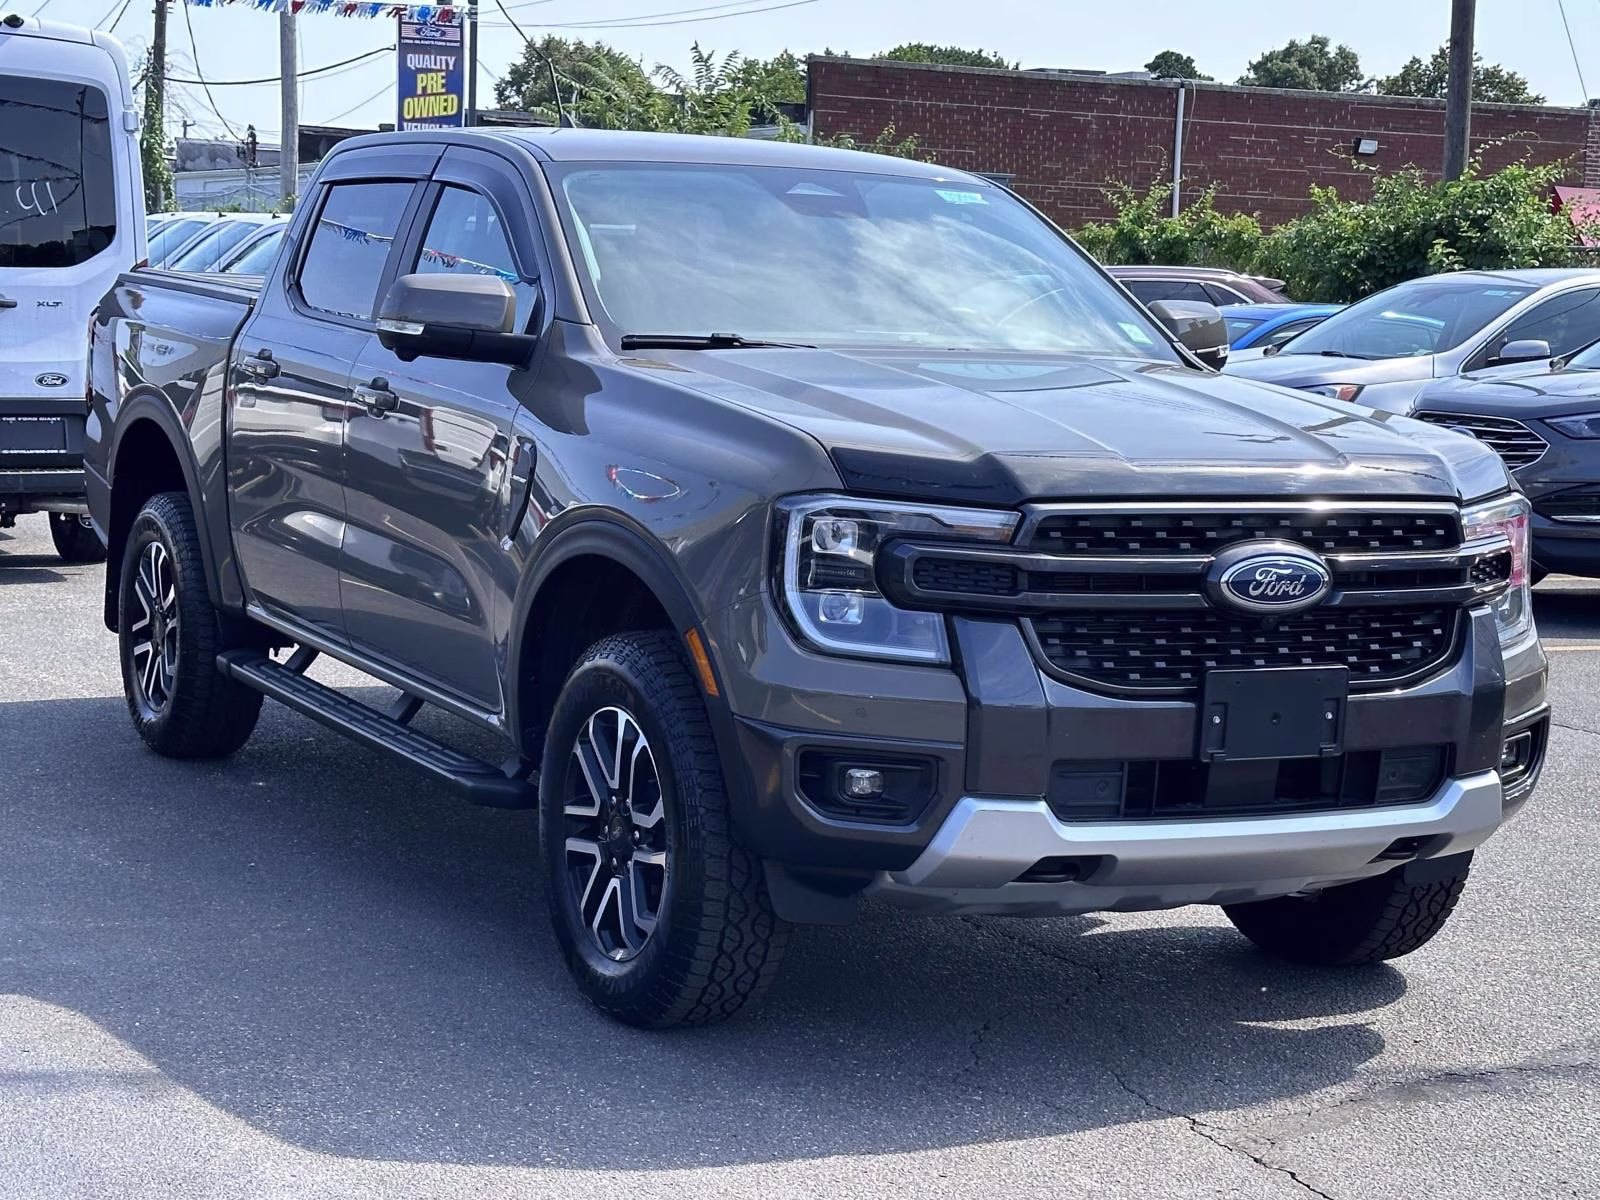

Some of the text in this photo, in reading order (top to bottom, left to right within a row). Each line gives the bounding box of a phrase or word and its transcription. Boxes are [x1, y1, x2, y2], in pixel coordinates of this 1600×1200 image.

[420, 27, 441, 36] Ford
[406, 54, 456, 70] QUALITY
[416, 72, 447, 95] PRE
[403, 94, 458, 119] OWNED
[42, 376, 63, 385] Ford
[1249, 567, 1307, 596] Ford
